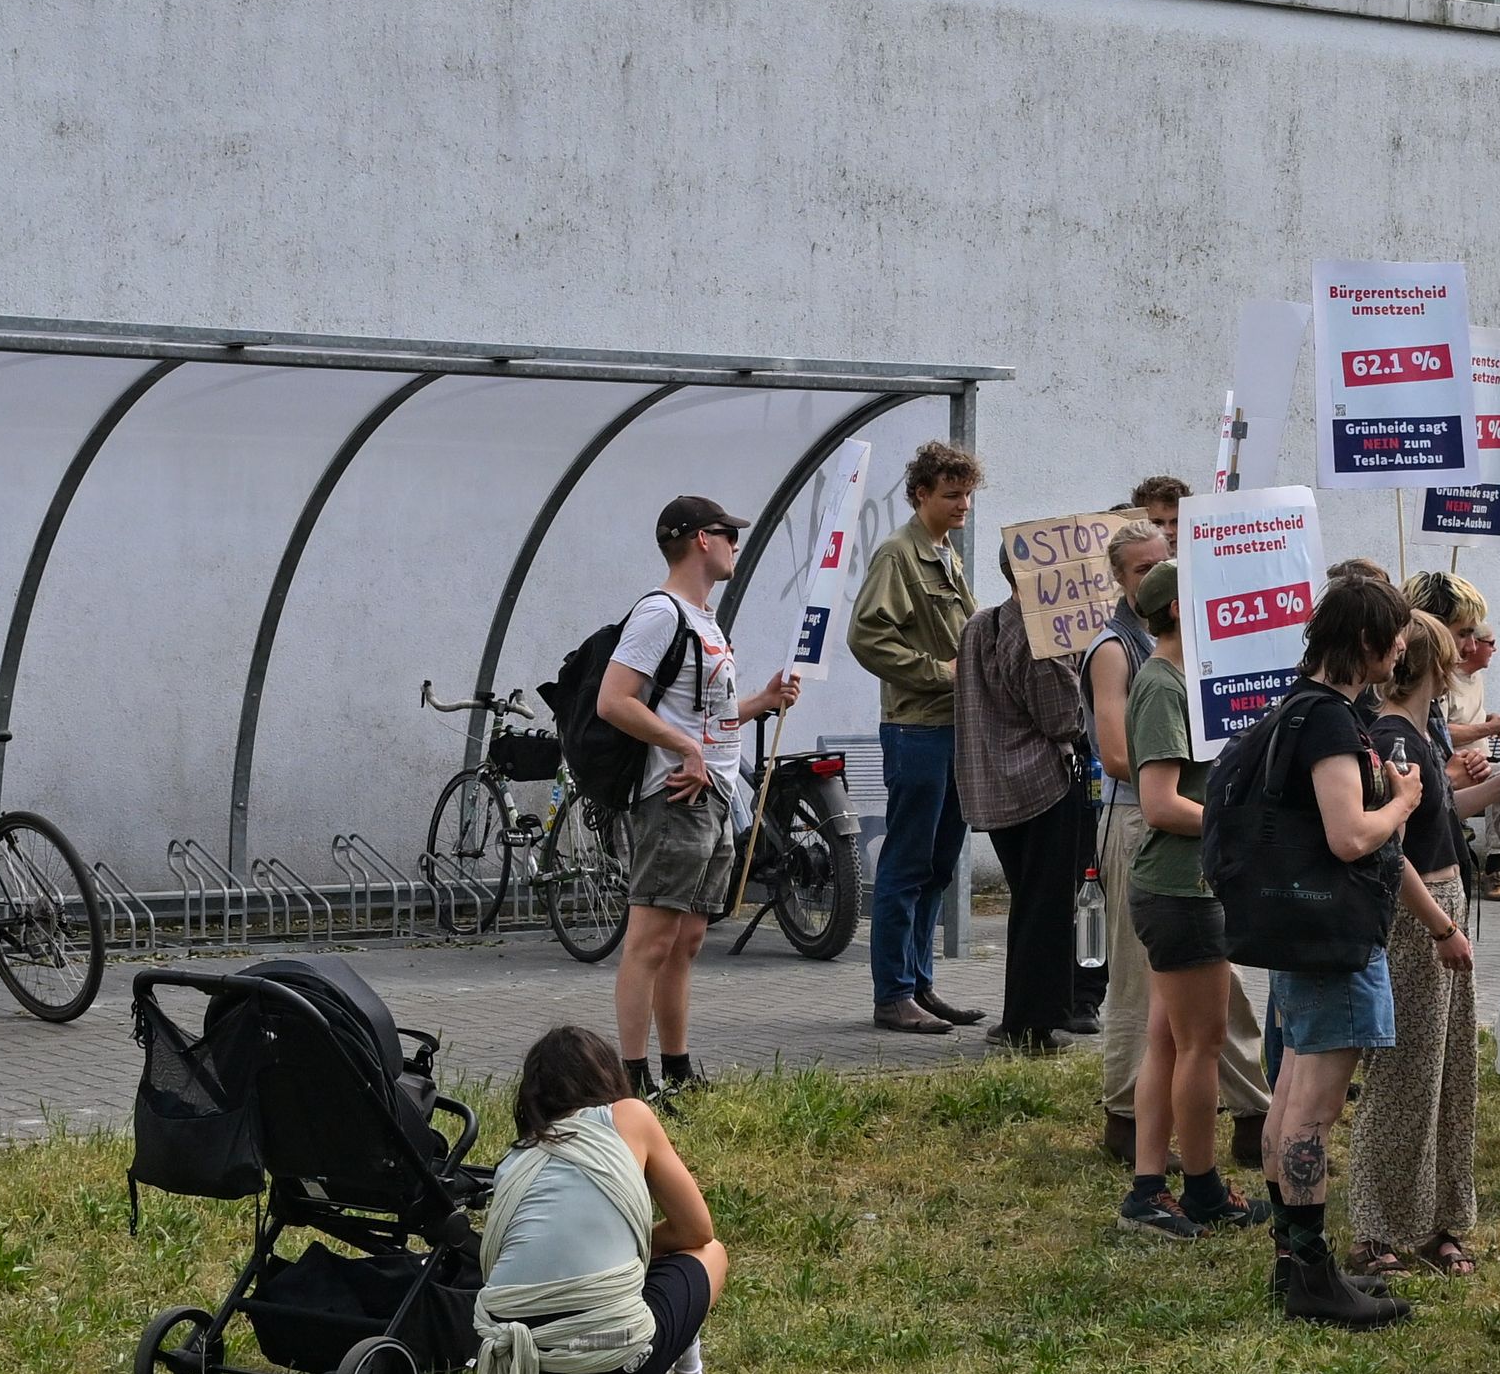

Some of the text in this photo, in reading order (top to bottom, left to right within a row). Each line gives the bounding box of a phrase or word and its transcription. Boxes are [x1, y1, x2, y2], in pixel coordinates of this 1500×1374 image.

[1329, 285, 1447, 302] Bürgerentscheid
[1352, 303, 1425, 316] umsetzen!
[1352, 351, 1442, 376] 62.1 %
[1345, 421, 1448, 435] Grünheide sagt
[1363, 438, 1431, 450] NEIN zum
[1353, 453, 1444, 467] Tesla-Ausbau
[1482, 488, 1499, 500] sagt
[1472, 504, 1487, 514] zum
[1193, 514, 1304, 541] Bürgerentscheid
[1436, 515, 1492, 529] Tesla-Ausbau
[1032, 523, 1110, 566] STOP
[1214, 536, 1286, 557] umsetzen!
[1217, 590, 1304, 627] 62.1 %
[1213, 674, 1280, 695] Grünheide
[1230, 695, 1266, 711] NEIN
